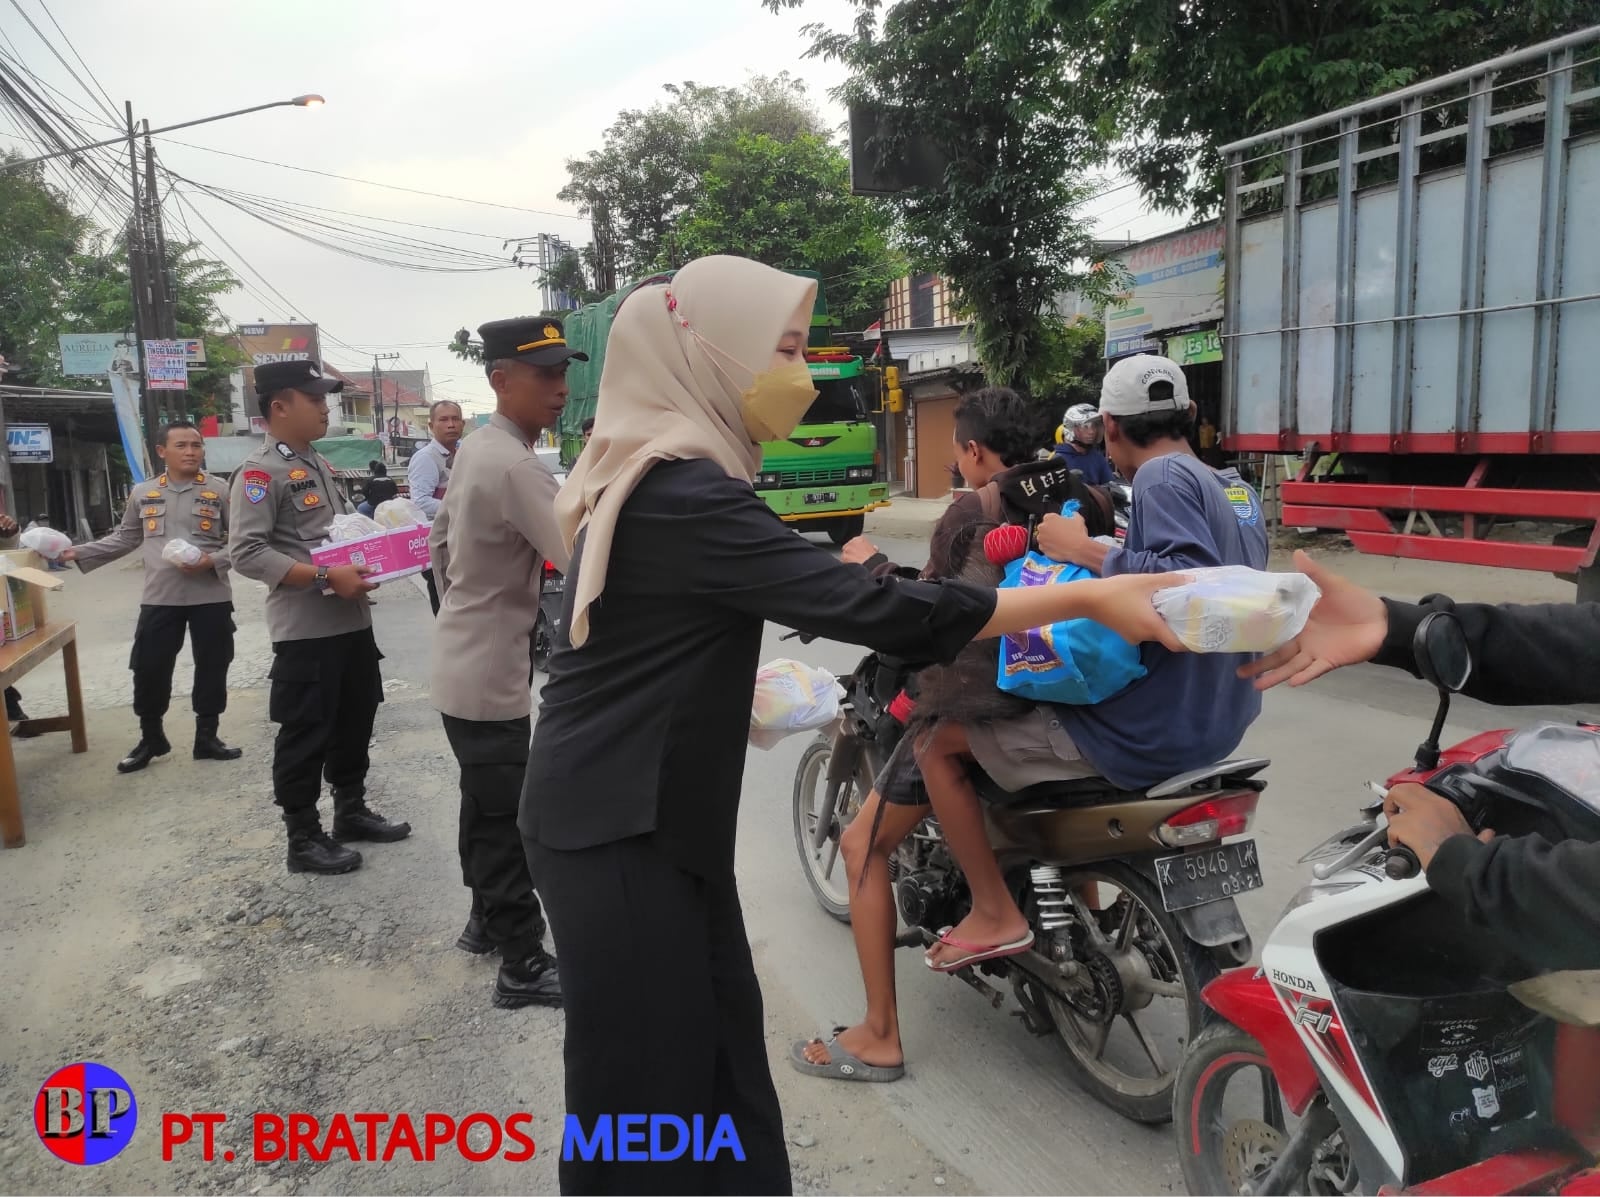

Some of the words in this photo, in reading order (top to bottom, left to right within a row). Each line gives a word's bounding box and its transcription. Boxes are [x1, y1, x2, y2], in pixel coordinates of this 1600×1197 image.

[243, 327, 265, 335] NEW
[63, 342, 111, 353] AURELIA
[1187, 339, 1202, 355] Es
[1207, 332, 1222, 351] Te
[253, 352, 309, 365] SENIOR
[7, 431, 42, 445] JNE
[1185, 850, 1228, 881] 5946
[1272, 968, 1317, 993] HONDA
[1295, 1006, 1333, 1034] FI
